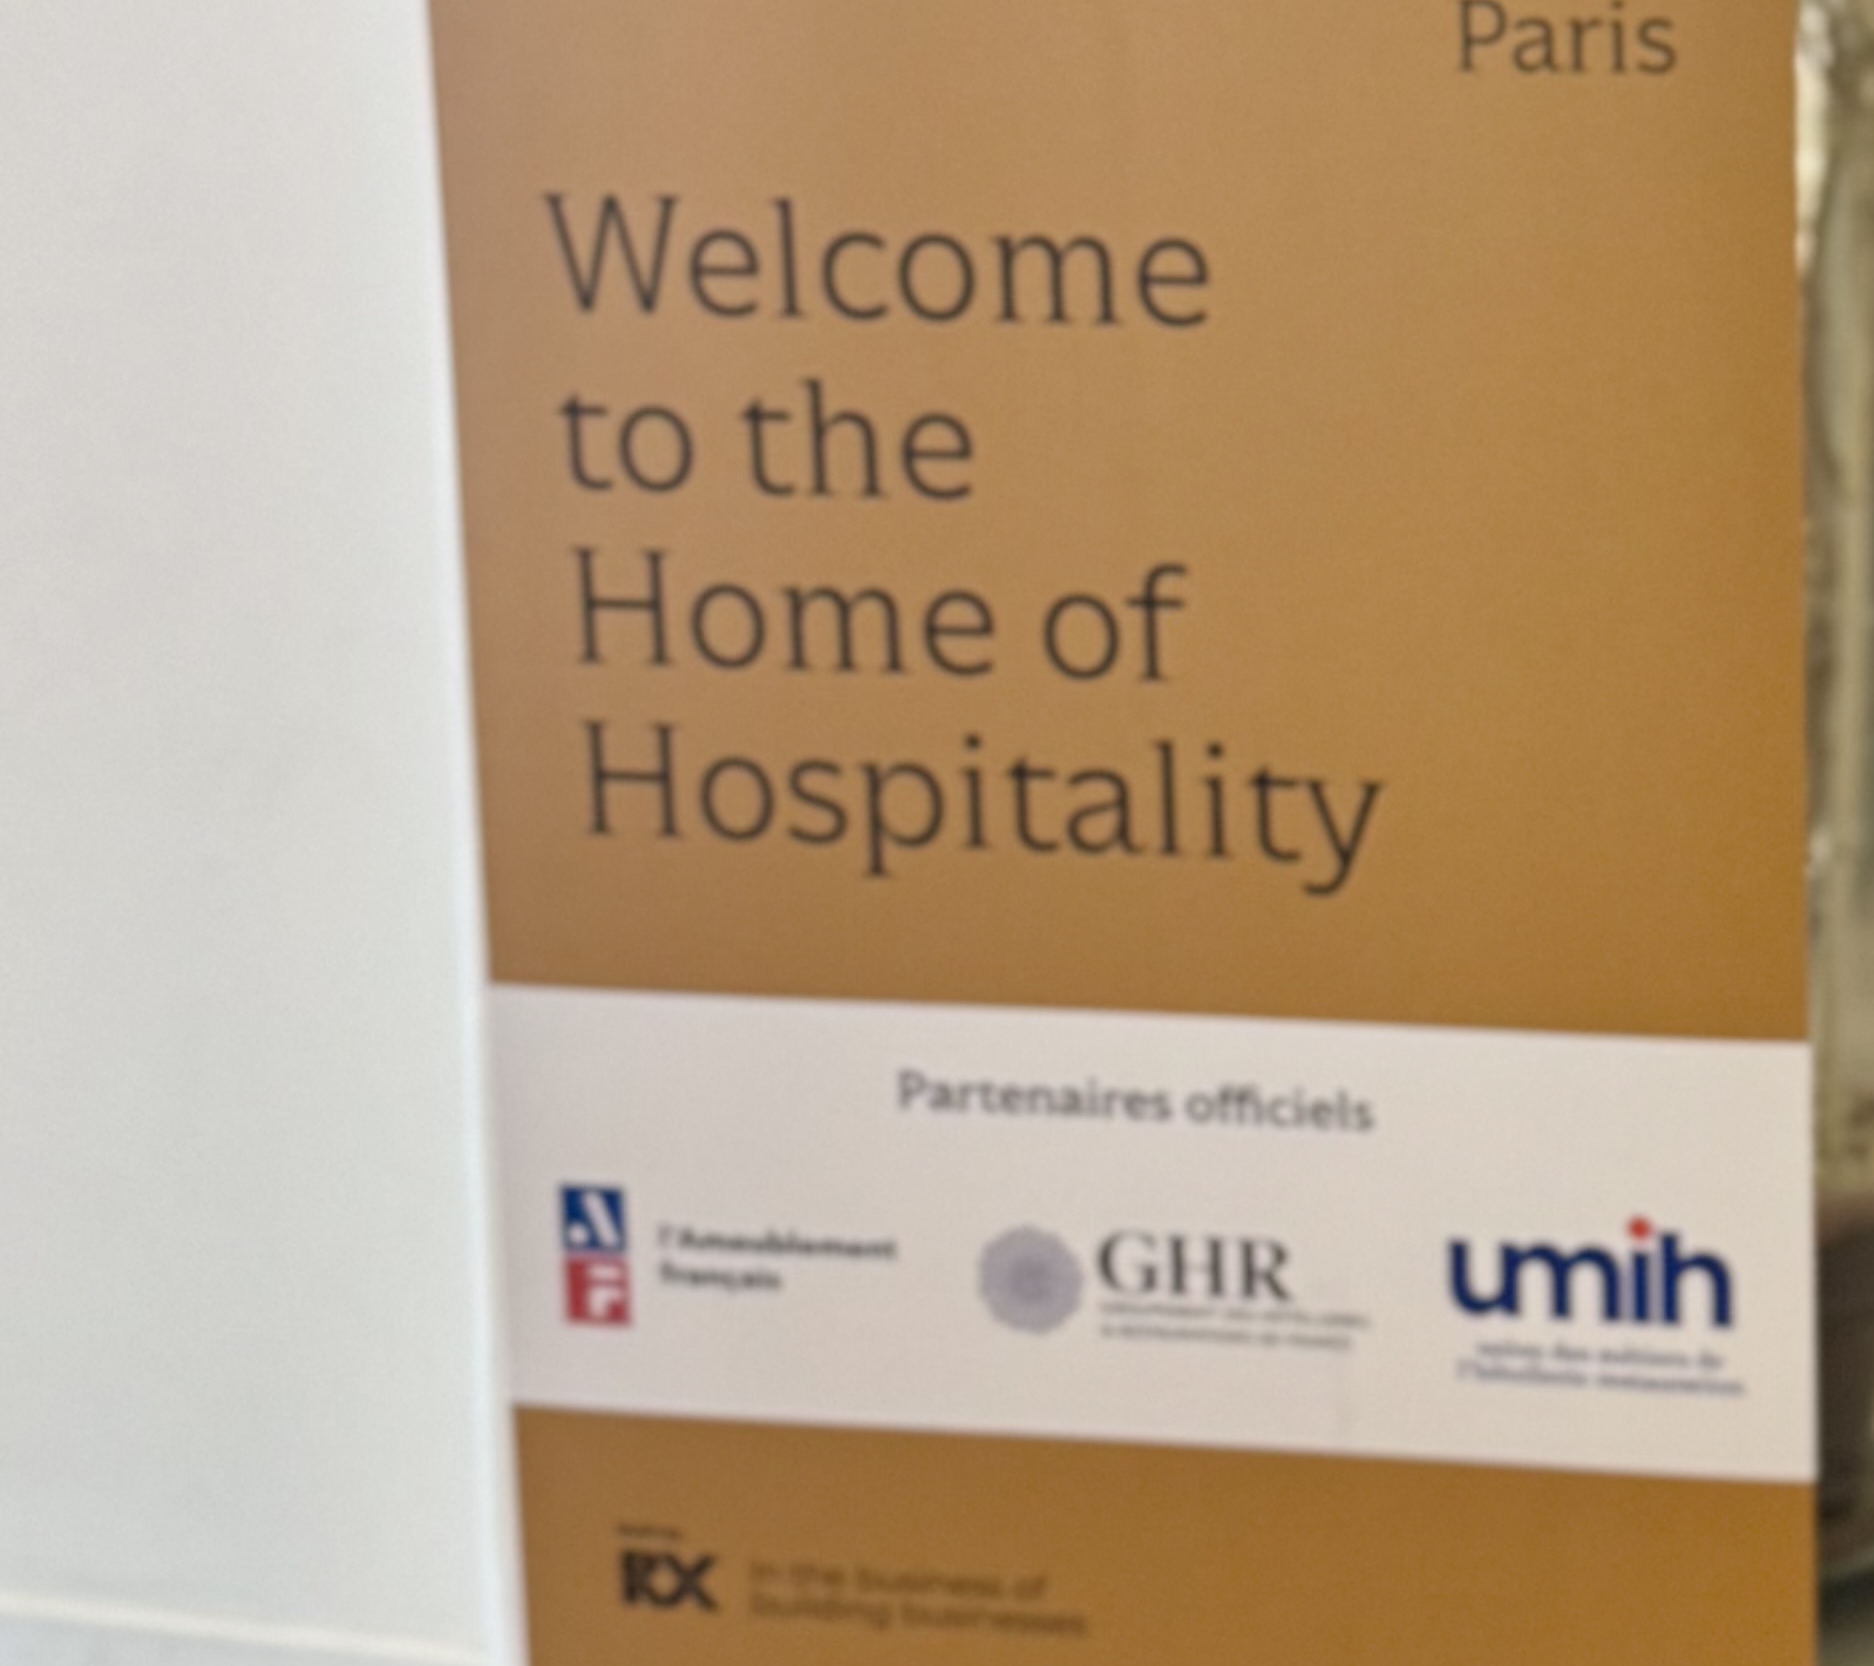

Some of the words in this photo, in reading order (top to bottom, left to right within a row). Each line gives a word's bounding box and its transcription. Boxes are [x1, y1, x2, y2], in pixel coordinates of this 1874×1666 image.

[542, 191, 1212, 331] Welcome
[557, 392, 697, 496] to
[738, 375, 976, 504] the
[572, 544, 998, 680] Home
[1040, 560, 1191, 684] of
[583, 718, 1385, 900] Hospitality
[896, 1066, 1174, 1125] Partenaires
[1182, 1082, 1377, 1135] officiels
[1094, 1230, 1293, 1304] GHR
[1446, 1217, 1735, 1331] umih
